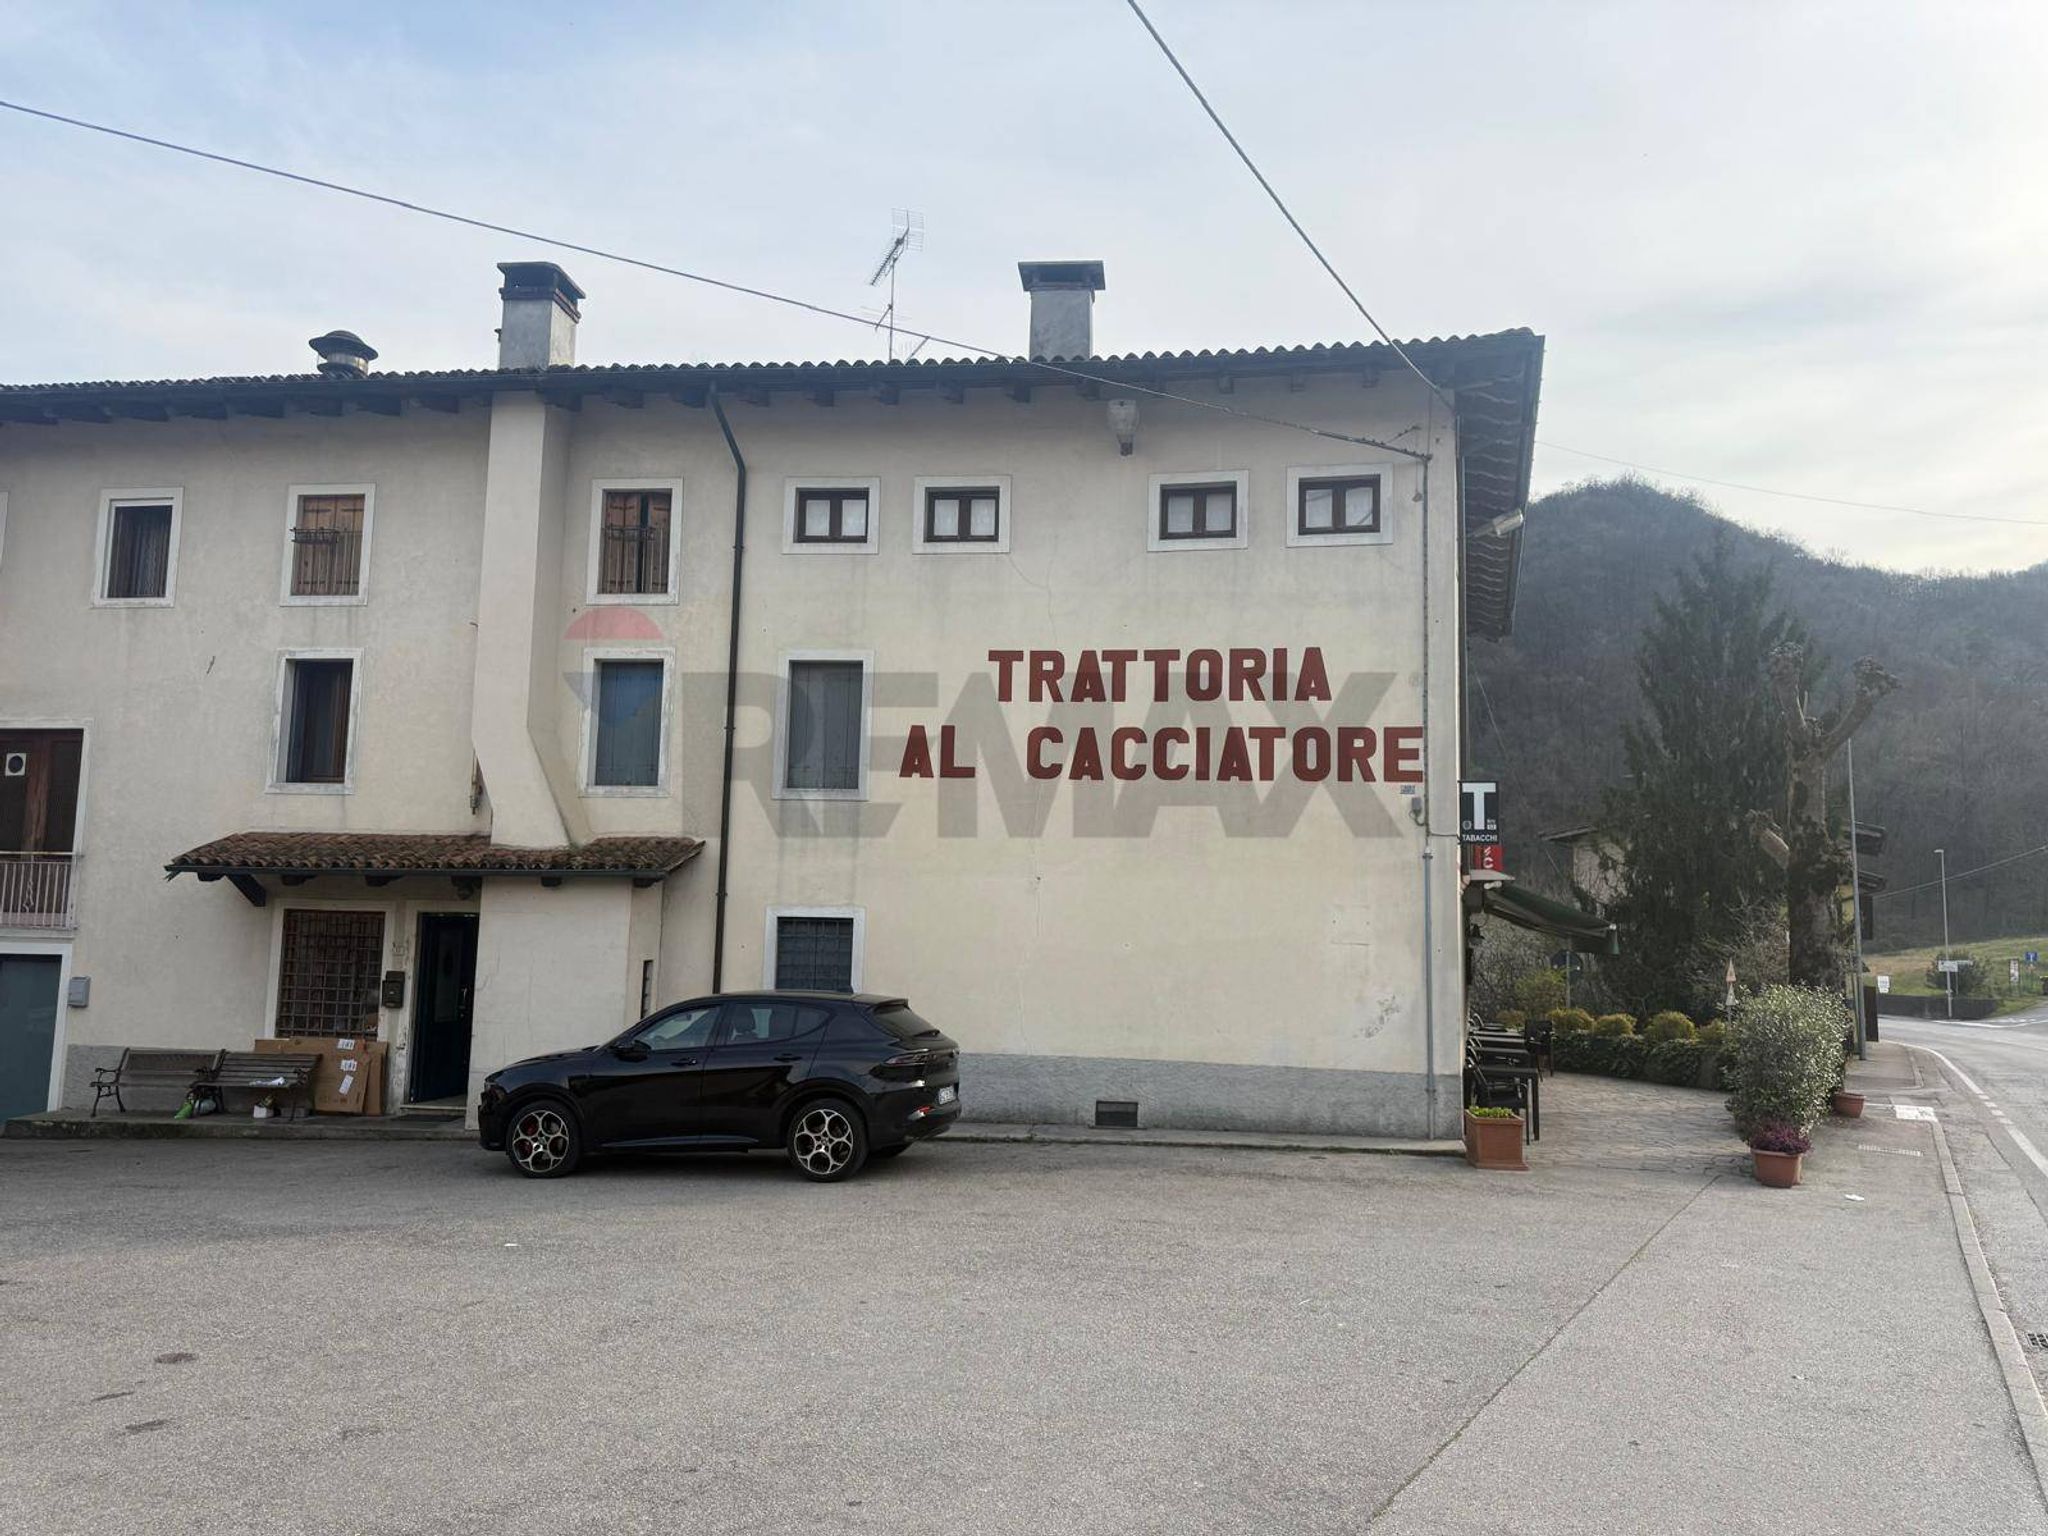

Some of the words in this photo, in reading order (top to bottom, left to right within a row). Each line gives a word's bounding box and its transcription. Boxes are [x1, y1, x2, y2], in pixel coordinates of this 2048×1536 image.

[988, 647, 1332, 702] TRATTORIA
[900, 725, 976, 777] AL
[1026, 726, 1423, 782] CACCIATORE
[1462, 782, 1496, 830] T
[1462, 834, 1498, 842] TABACCHI
